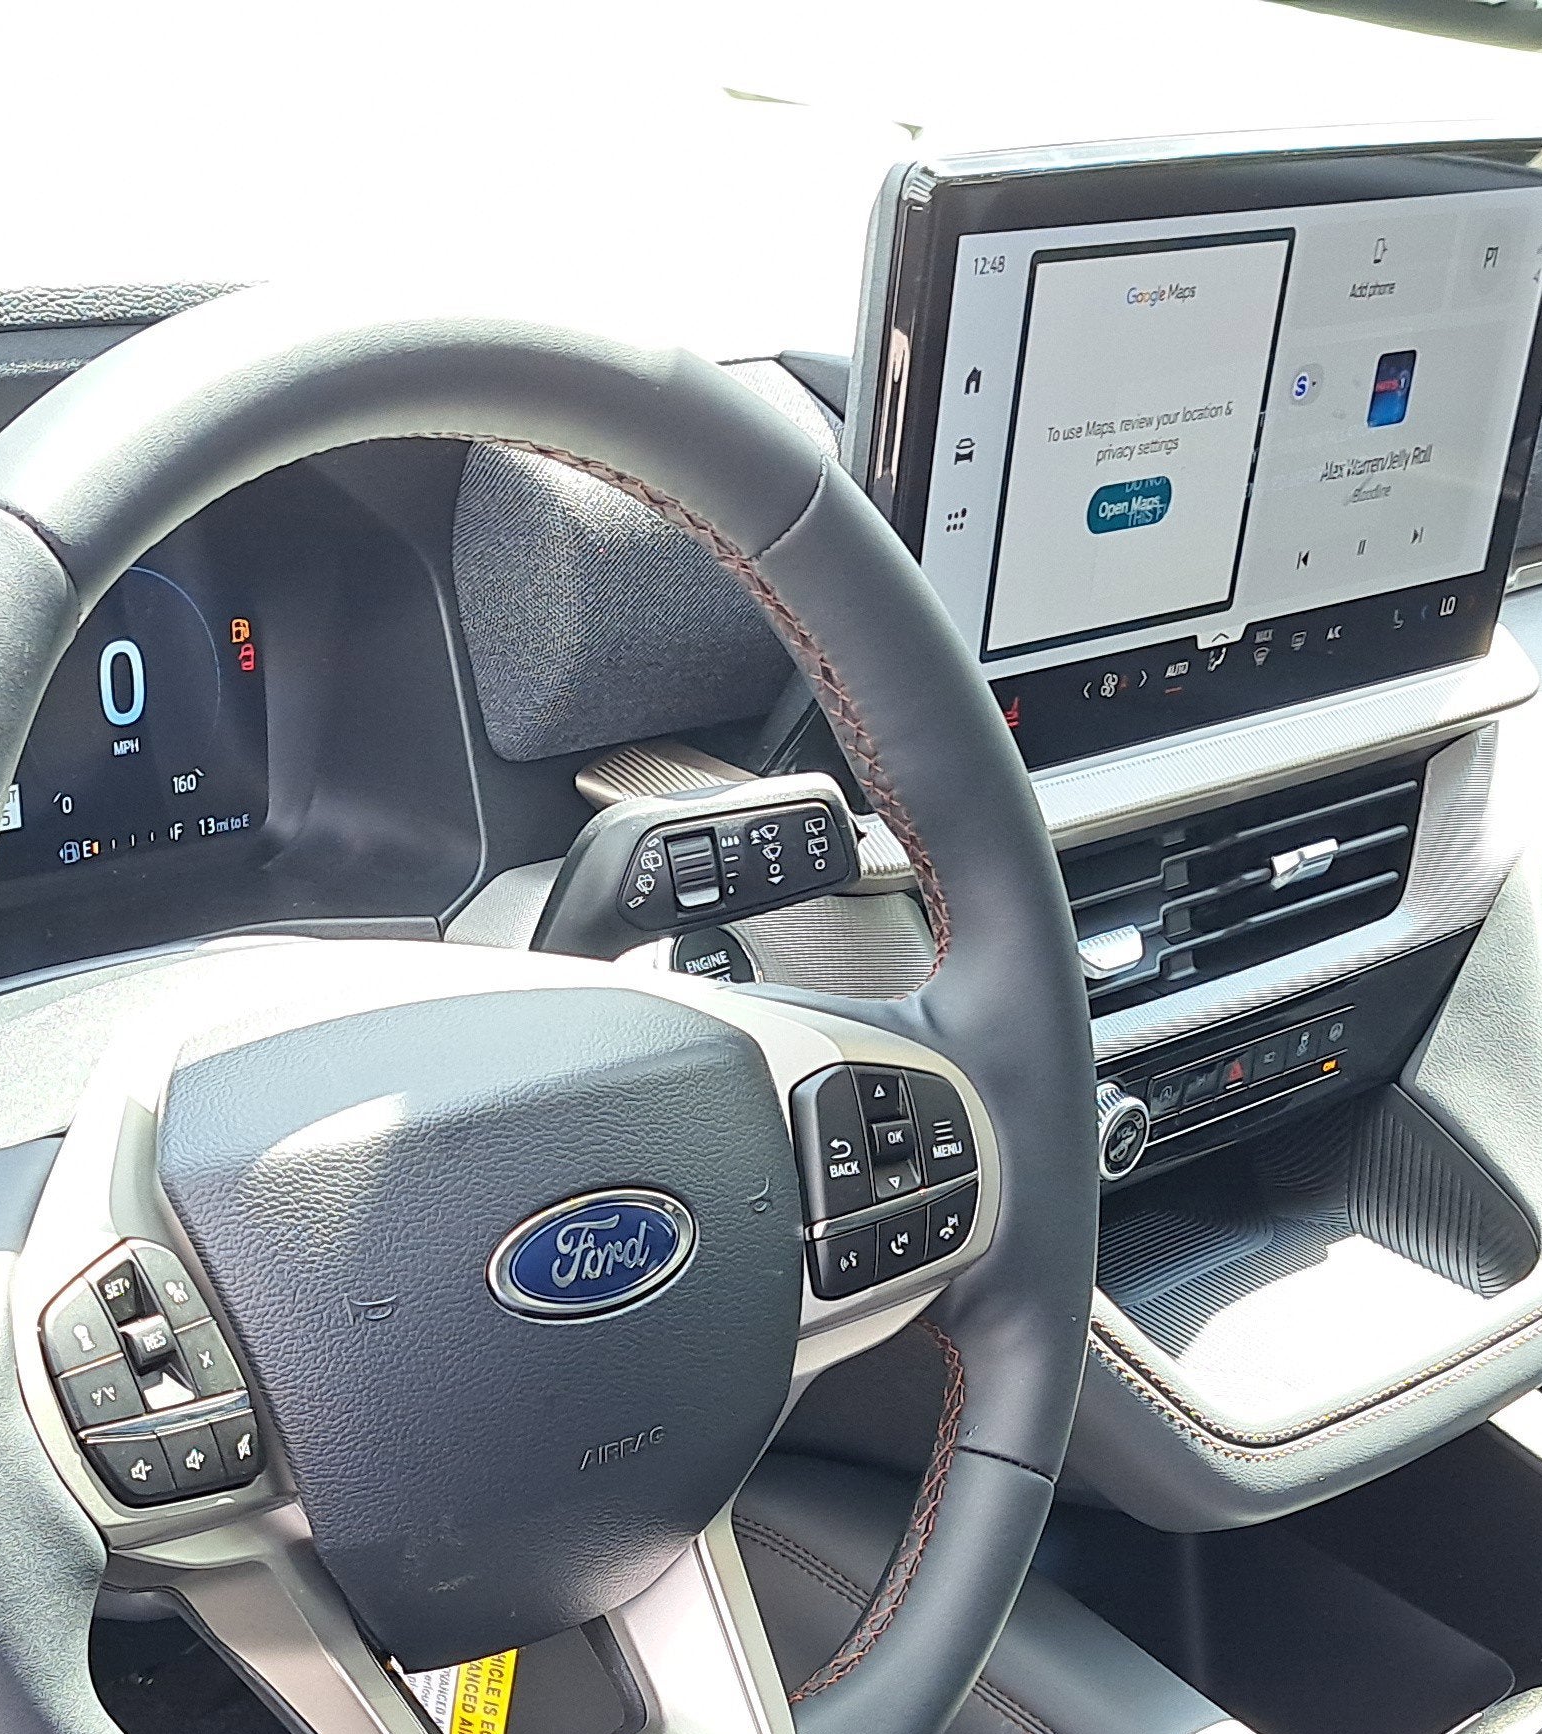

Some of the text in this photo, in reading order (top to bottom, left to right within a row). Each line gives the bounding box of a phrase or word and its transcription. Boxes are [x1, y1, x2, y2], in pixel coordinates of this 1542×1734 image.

[973, 256, 1006, 275] 12:48
[1127, 283, 1197, 306] Google Maps
[1349, 282, 1396, 299] Add phone
[1047, 401, 1234, 443] To use Maps, review your location &
[1095, 437, 1180, 465] privacy settings
[1098, 501, 1130, 520] Open
[1130, 495, 1162, 513] Maps
[1439, 595, 1456, 619] LO
[1164, 660, 1190, 678] AUTO
[99, 639, 146, 727] 0
[113, 738, 141, 756] MPH
[172, 774, 197, 794] 160
[62, 796, 73, 814] 0
[198, 817, 215, 836] 13
[82, 840, 93, 858] E
[685, 950, 730, 974] ENGINE
[887, 1130, 904, 1145] OK
[932, 1140, 963, 1159] MENU
[829, 1160, 860, 1179] BACK
[550, 1213, 651, 1289] Ford
[142, 1331, 167, 1353] RES
[579, 1425, 666, 1472] AIRBAG
[482, 1700, 499, 1717] IS
